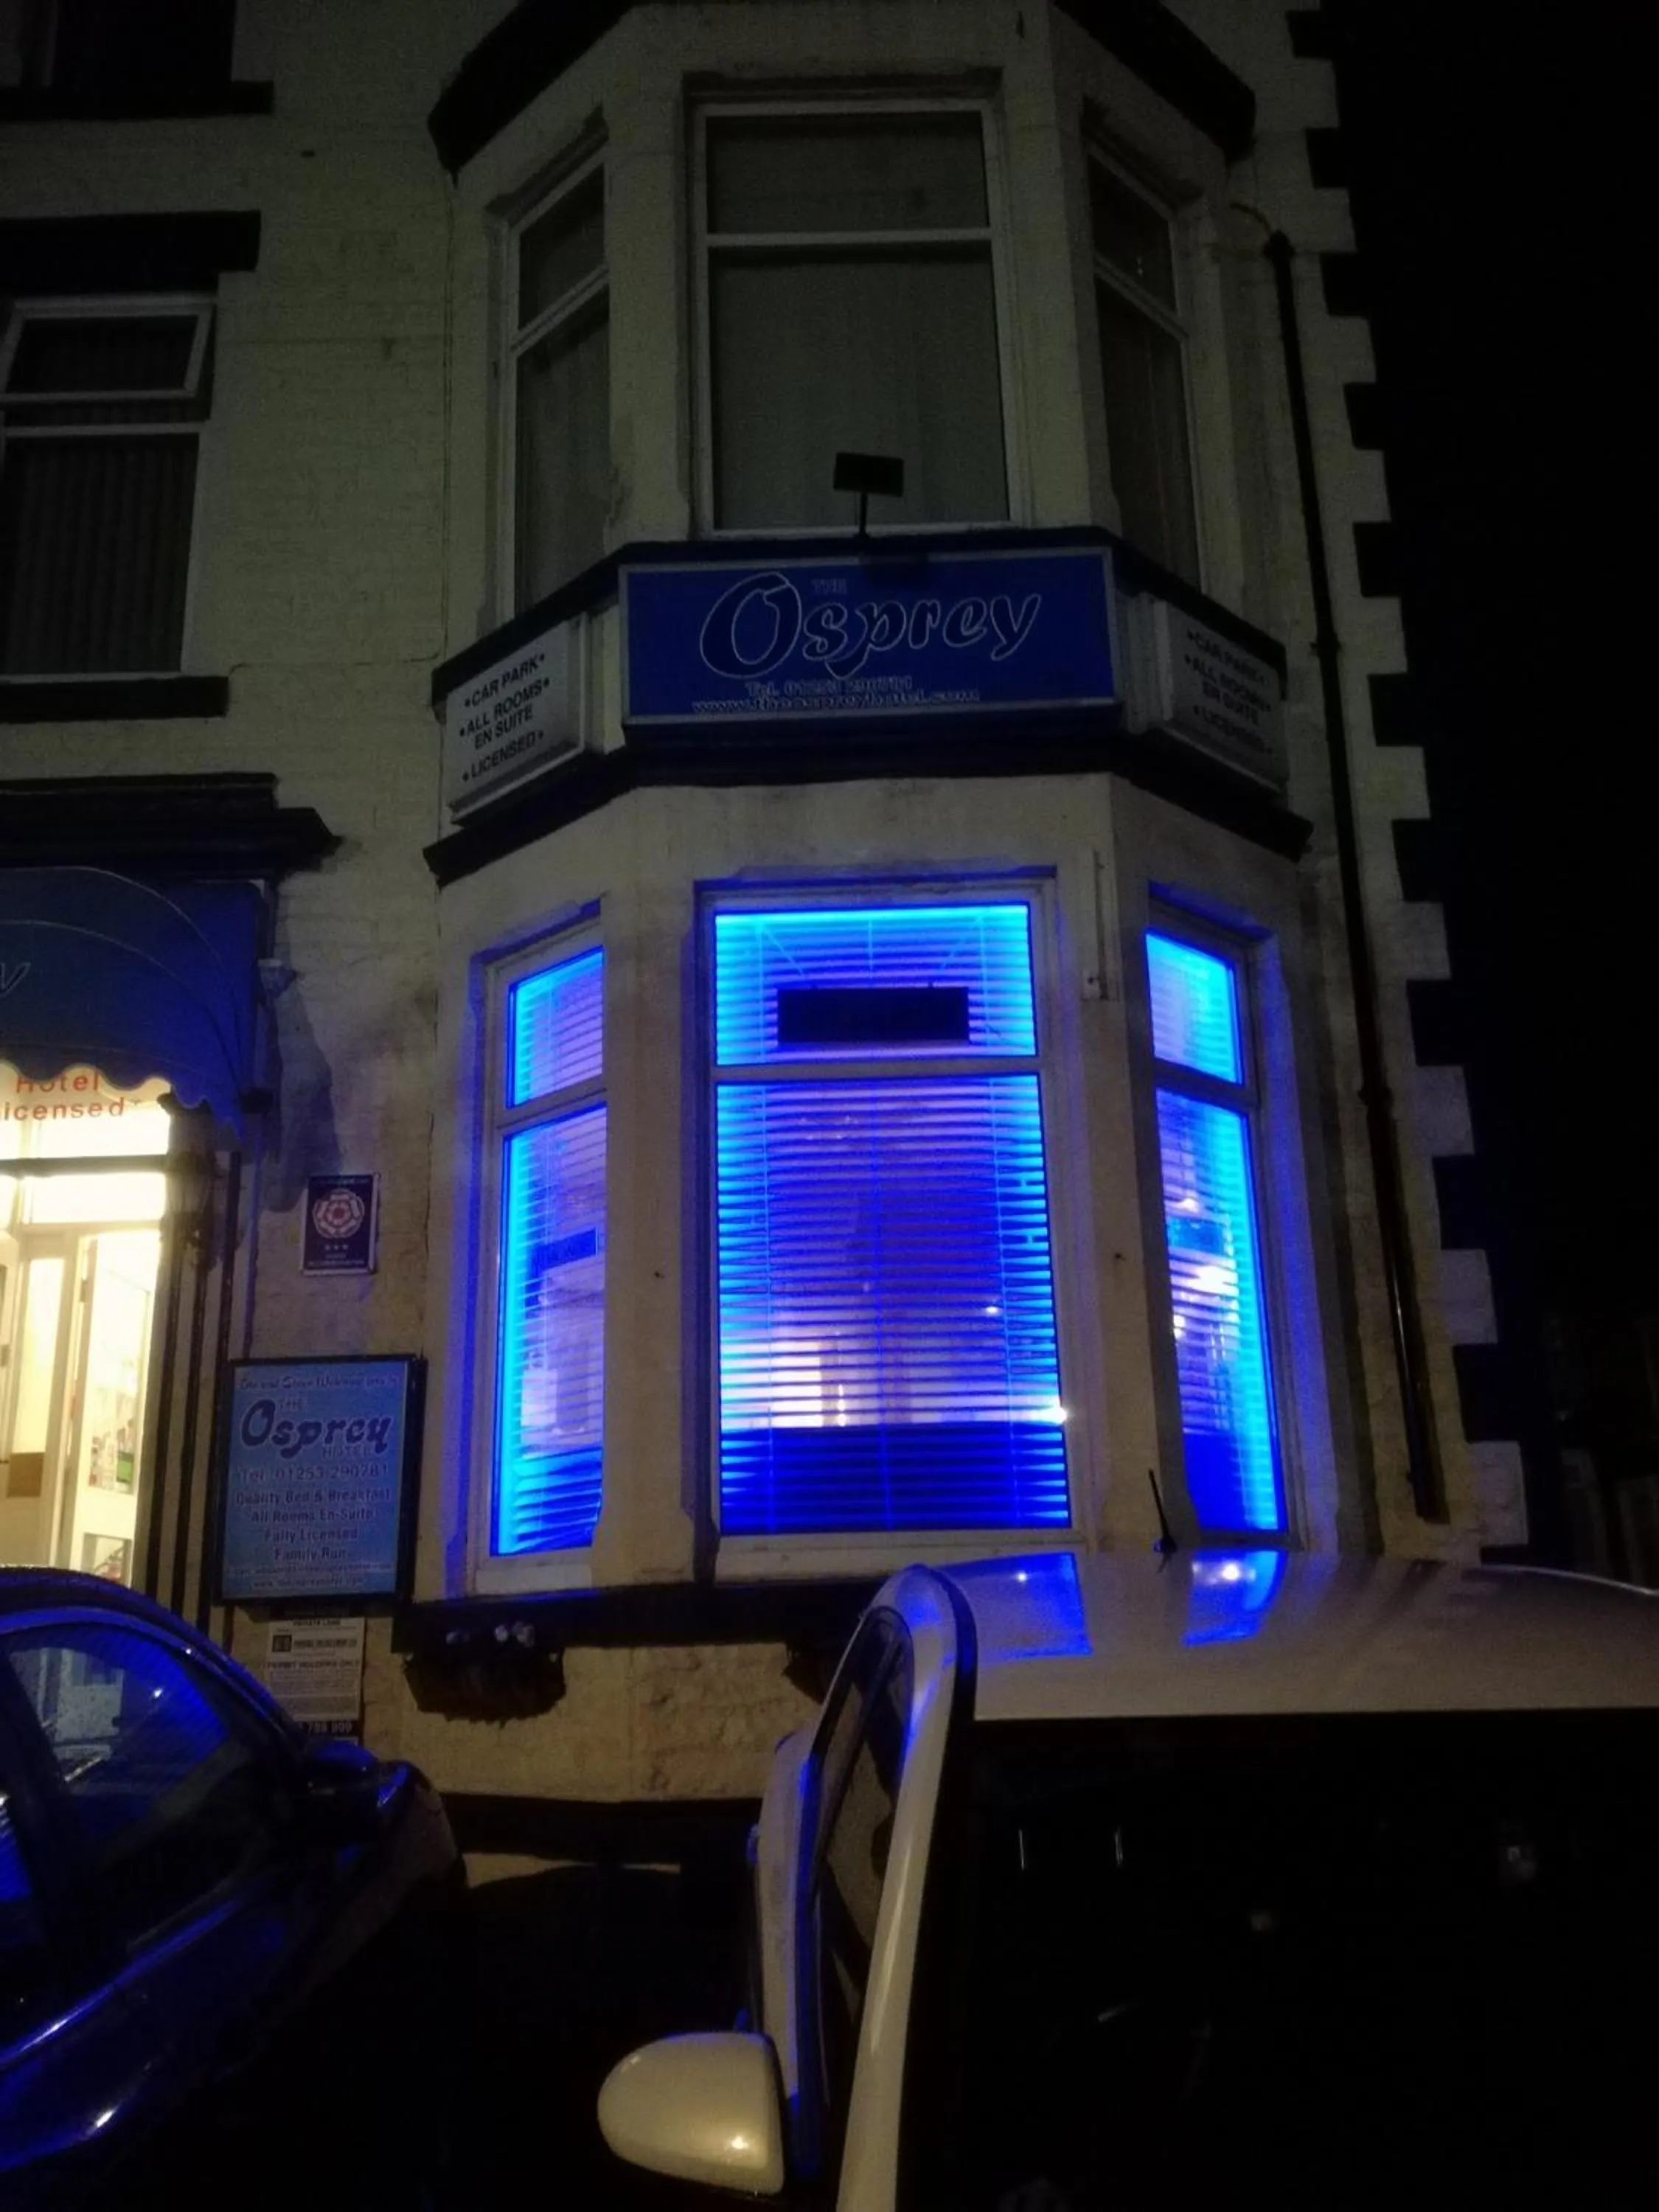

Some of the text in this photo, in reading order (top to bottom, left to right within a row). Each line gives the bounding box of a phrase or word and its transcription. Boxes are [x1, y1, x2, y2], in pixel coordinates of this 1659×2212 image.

[700, 571, 1043, 680] Osprey
[472, 654, 540, 706] CAR PARK
[467, 678, 542, 734] ALL ROOMS
[475, 704, 532, 749] EN SUITE
[471, 732, 536, 778] LICENSED
[17, 1071, 99, 1093] Hotel
[4, 1096, 124, 1121] icensed
[240, 1399, 392, 1458] Osprey
